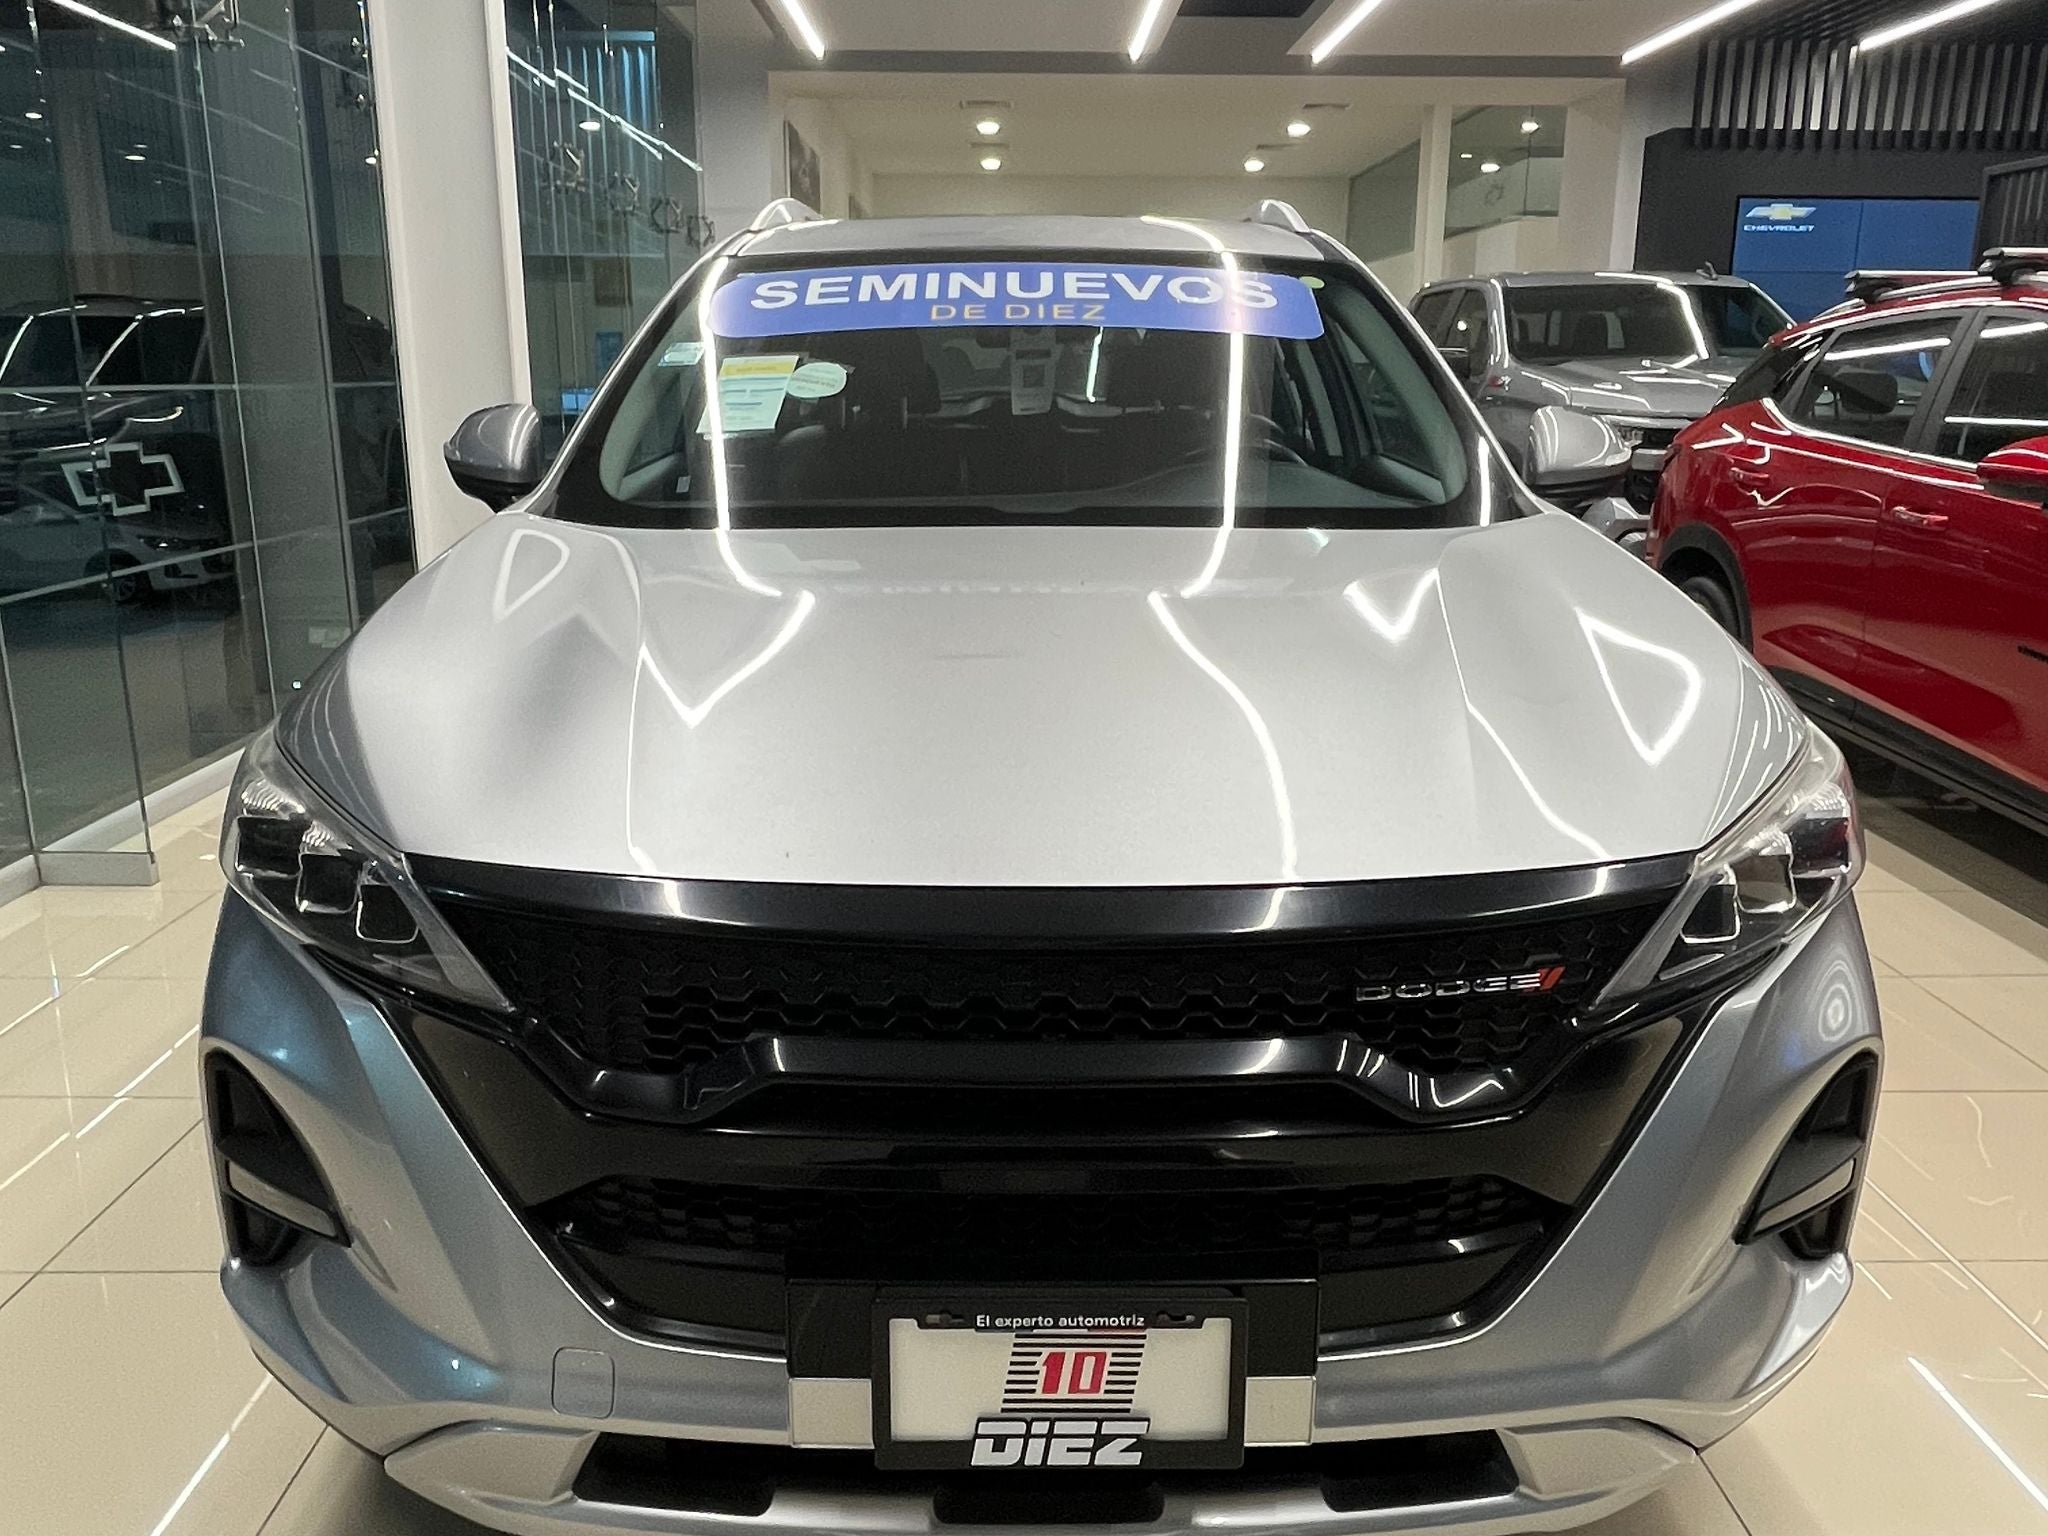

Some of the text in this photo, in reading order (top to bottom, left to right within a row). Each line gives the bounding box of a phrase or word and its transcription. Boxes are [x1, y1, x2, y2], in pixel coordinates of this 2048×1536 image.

[1743, 224, 1815, 232] CHEVROLET
[749, 271, 1279, 309] SEMINUEVOS
[931, 303, 1105, 320] DE DIEZ
[1356, 972, 1541, 1001] DODGE
[976, 1314, 1145, 1329] El experto automotriz
[1041, 1351, 1107, 1395] 10
